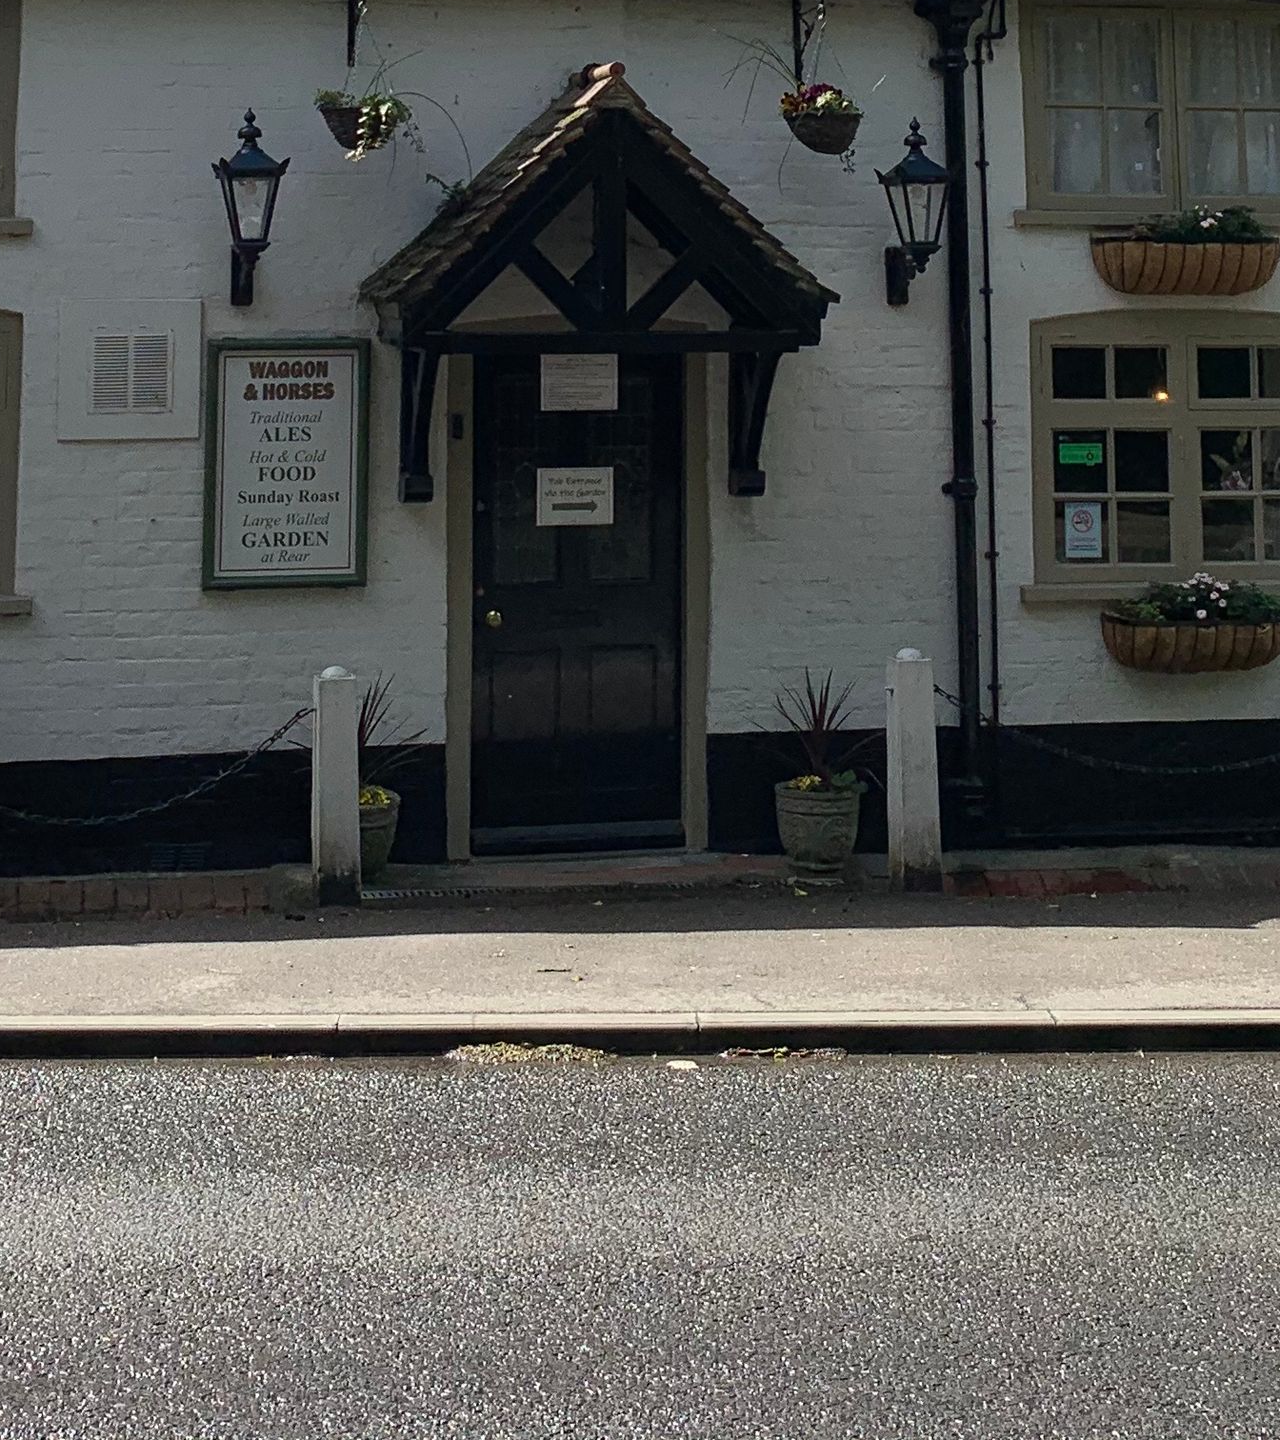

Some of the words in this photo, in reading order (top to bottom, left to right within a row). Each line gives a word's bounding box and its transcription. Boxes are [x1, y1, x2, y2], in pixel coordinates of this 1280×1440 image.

[249, 361, 328, 379] WAGGON
[243, 383, 258, 401] &
[262, 382, 335, 401] HORSES
[250, 411, 322, 425] Traditional
[259, 426, 312, 442] ALES
[249, 451, 273, 464] Hot
[277, 450, 290, 462] &
[294, 449, 326, 463] Cold
[258, 466, 316, 482] FOOD
[237, 490, 293, 506] Sunday
[298, 489, 340, 503] Roast
[242, 514, 281, 529] Large
[286, 512, 330, 527] Walled
[241, 530, 329, 548] GARDEN
[261, 552, 274, 564] at
[278, 550, 310, 563] Rear
